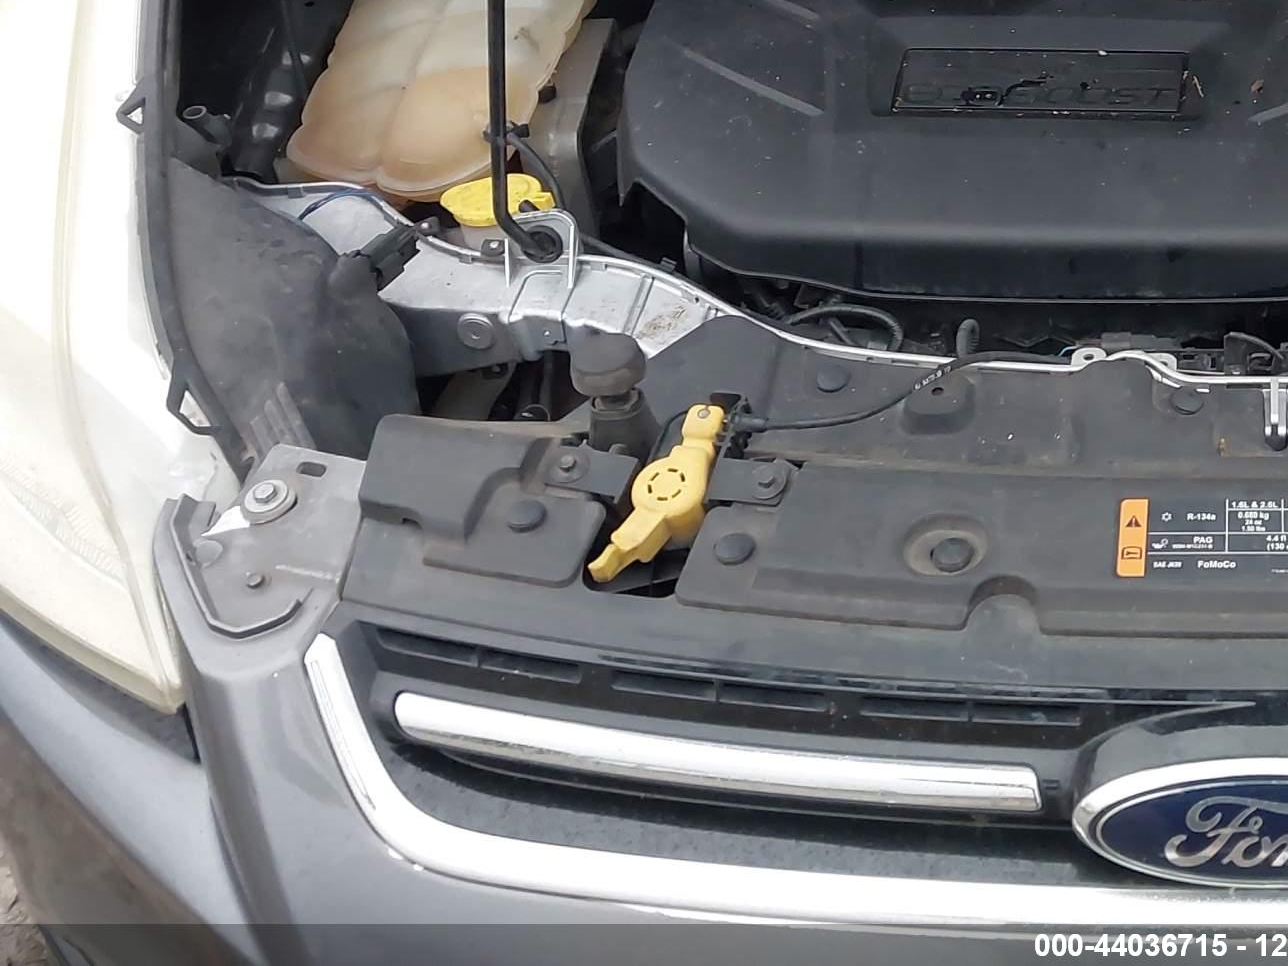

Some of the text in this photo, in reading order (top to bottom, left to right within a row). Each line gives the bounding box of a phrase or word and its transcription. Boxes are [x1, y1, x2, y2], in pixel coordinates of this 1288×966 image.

[1251, 500, 1259, 508] &
[1186, 513, 1217, 521] R-134a
[1259, 511, 1270, 521] kg
[1193, 536, 1213, 544] PAG
[1266, 543, 1285, 551] (130
[1197, 560, 1237, 569] FoMoCo
